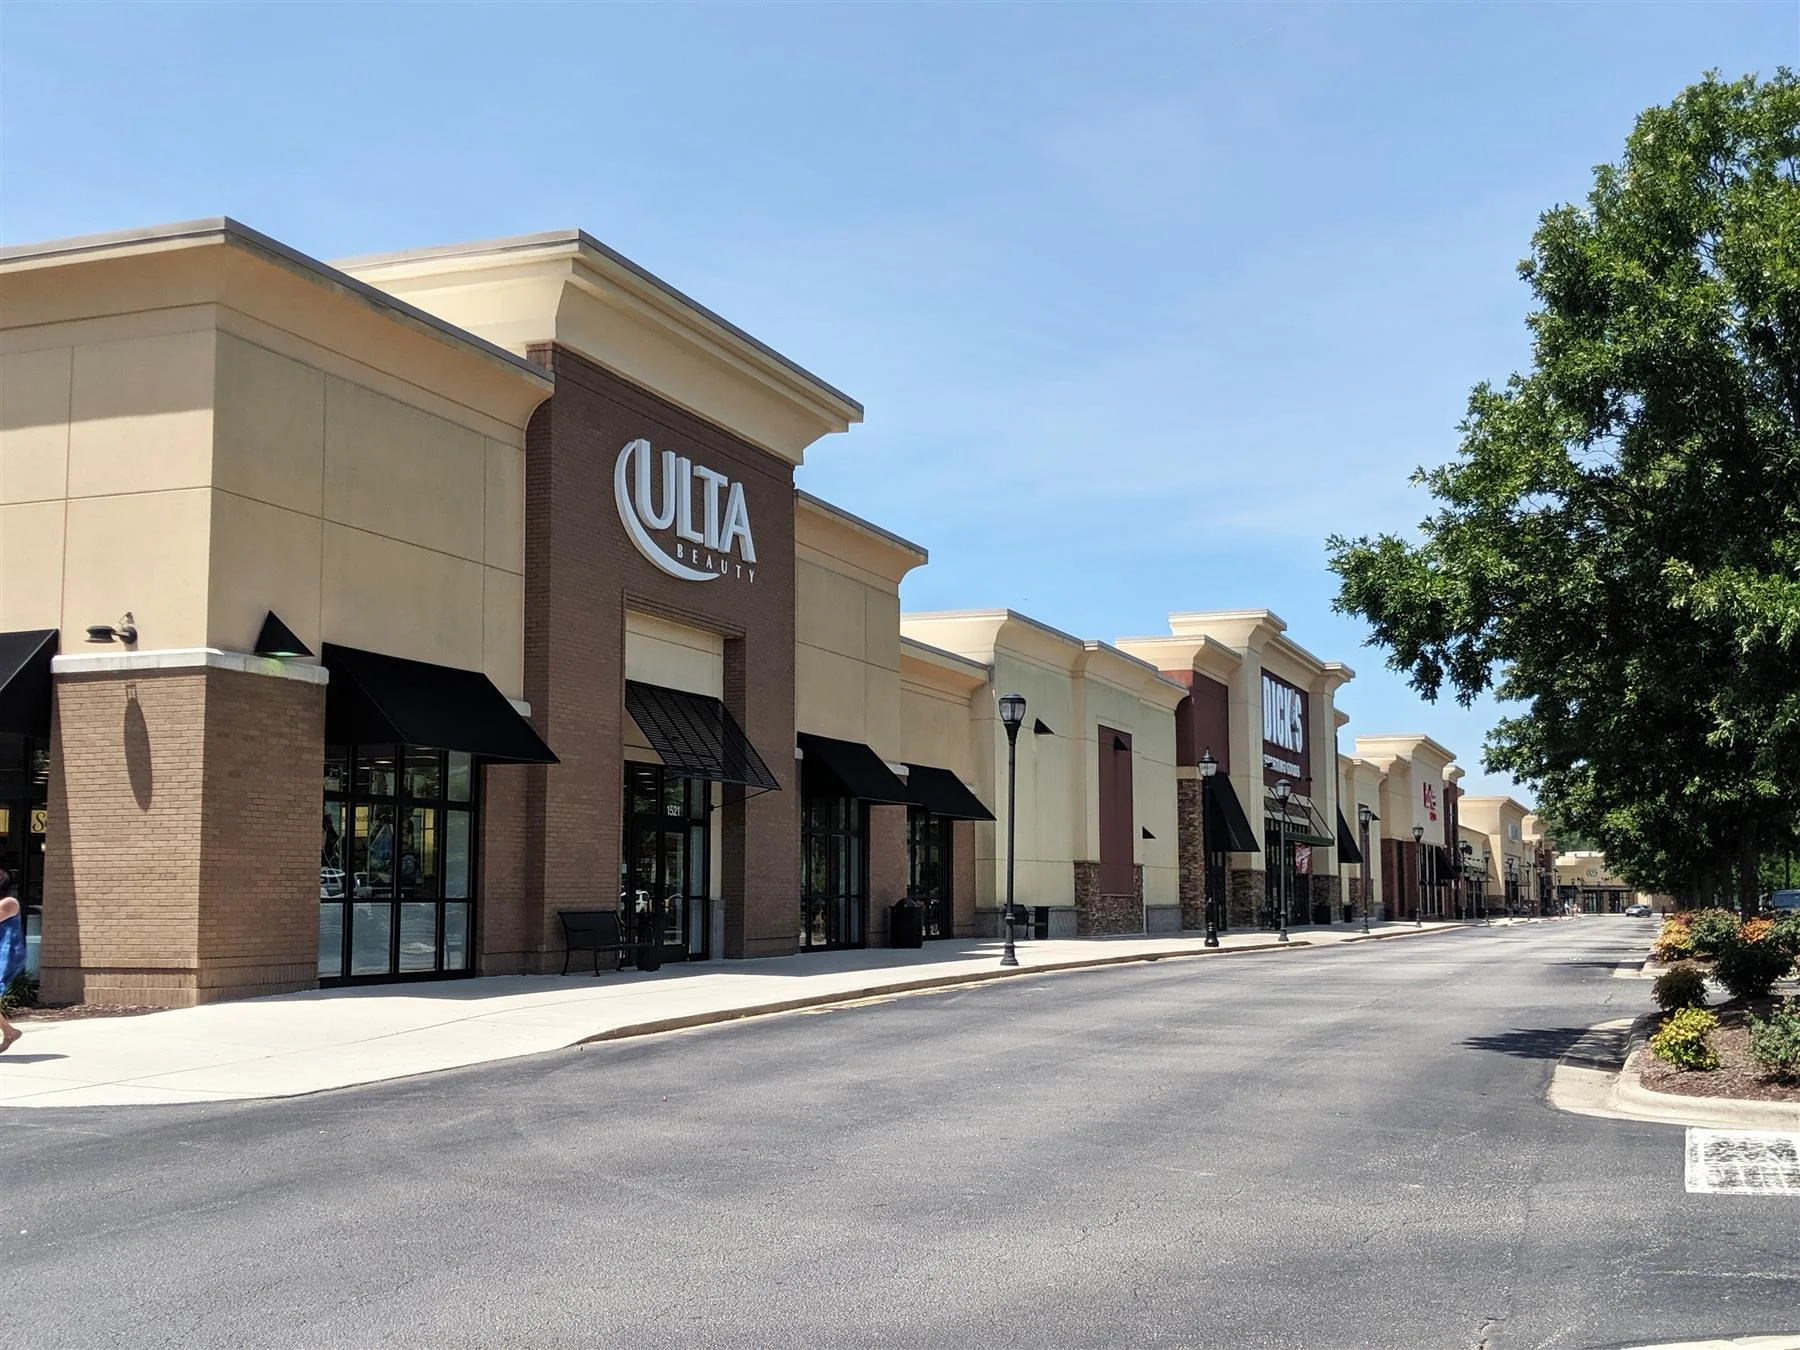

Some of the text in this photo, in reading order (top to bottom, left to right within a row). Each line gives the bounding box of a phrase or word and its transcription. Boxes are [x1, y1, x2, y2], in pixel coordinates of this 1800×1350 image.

[635, 438, 757, 563] ULTA
[676, 543, 756, 584] BEAUTY
[666, 804, 680, 817] 1521
